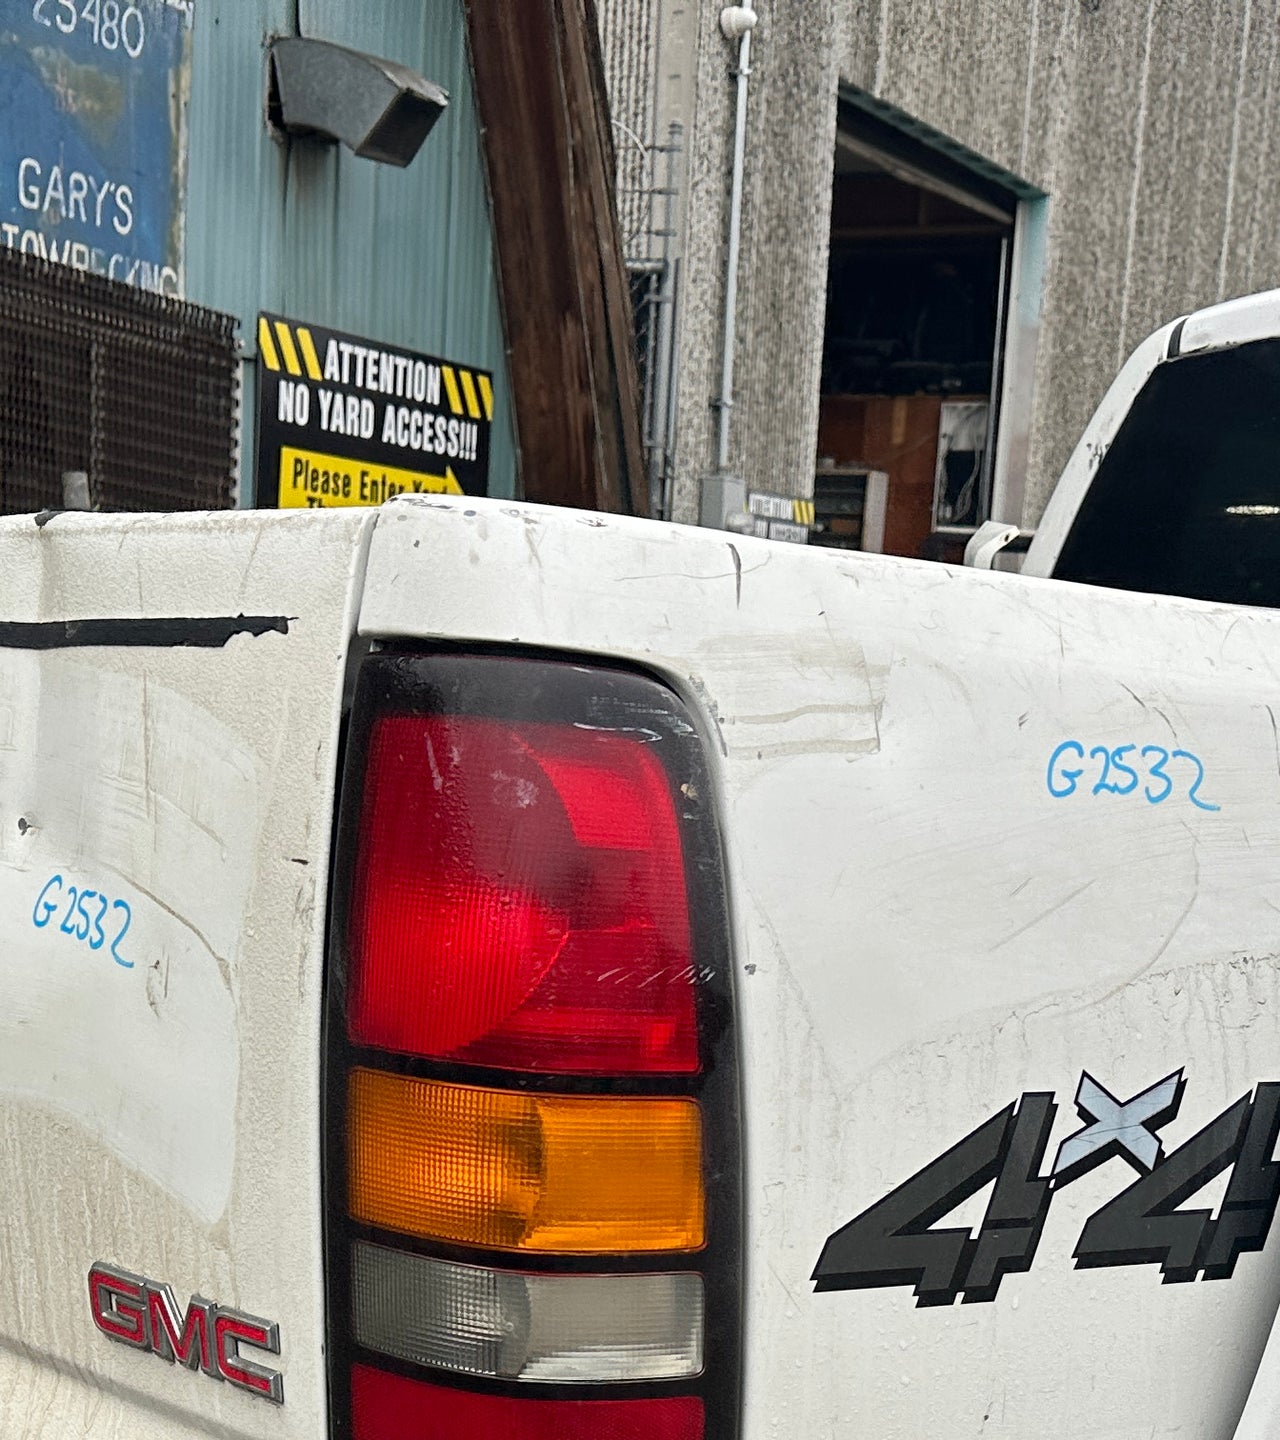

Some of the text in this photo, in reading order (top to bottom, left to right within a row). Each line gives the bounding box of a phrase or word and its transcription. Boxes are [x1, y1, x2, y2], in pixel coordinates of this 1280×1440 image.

[18, 157, 133, 236] GARY'S
[324, 338, 442, 406] ATTENTION
[277, 379, 478, 463] NO YARD ACCESS!!!
[293, 457, 352, 498] Please
[1046, 740, 1222, 811] G2532
[32, 873, 136, 969] G2532
[87, 1259, 285, 1406] GMC
